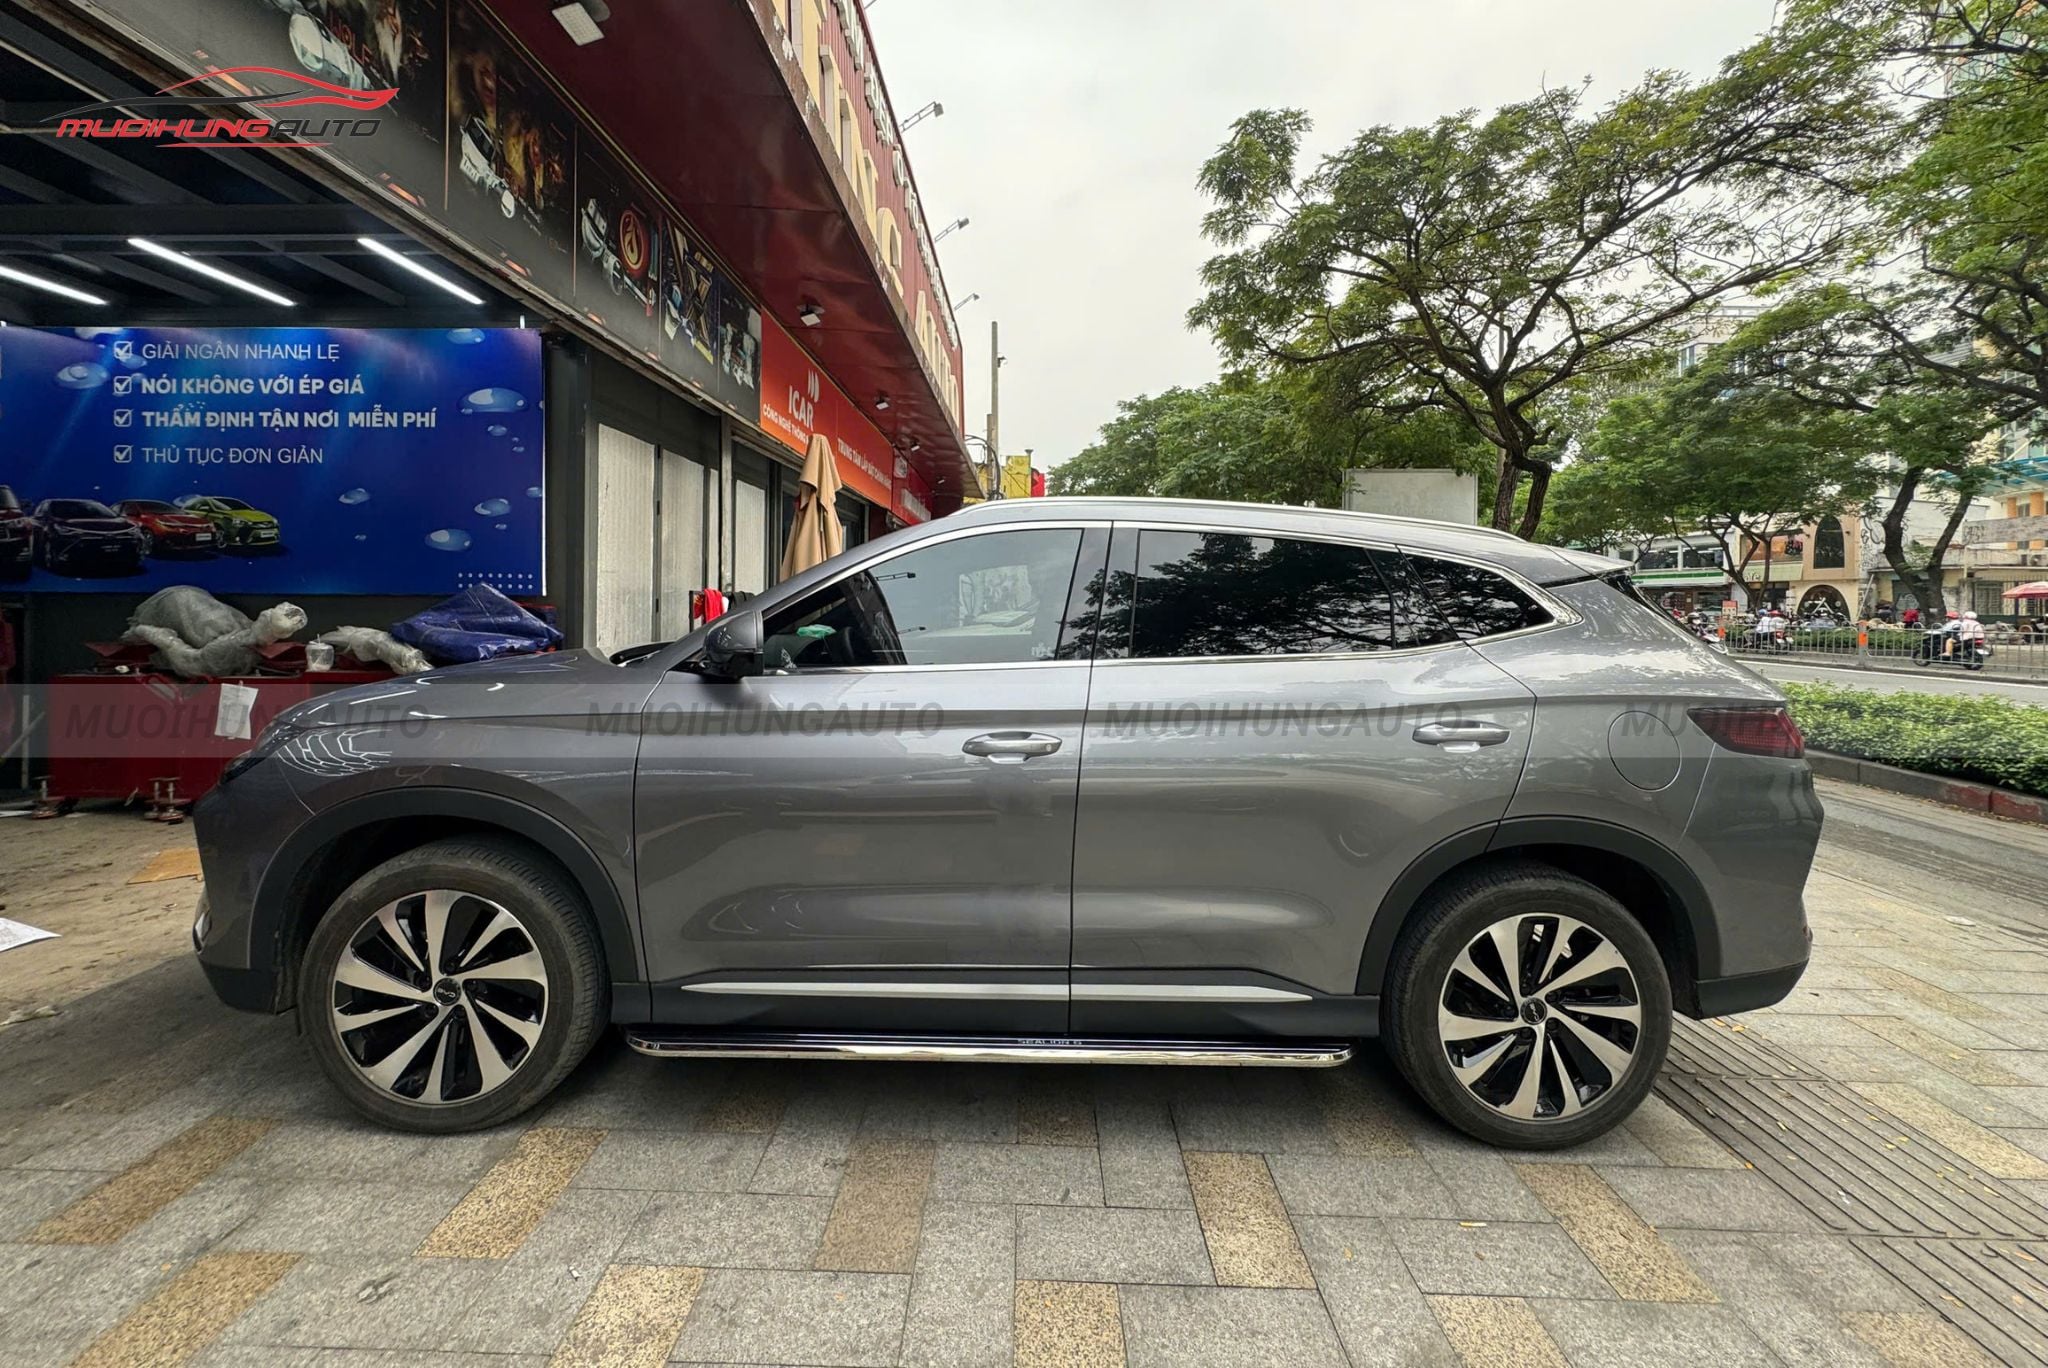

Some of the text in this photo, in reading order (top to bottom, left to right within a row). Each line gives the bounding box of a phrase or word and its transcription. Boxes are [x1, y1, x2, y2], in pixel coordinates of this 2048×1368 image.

[142, 340, 340, 362] GIẢI NGÂN NHANH LẸ
[141, 373, 365, 395] NÓI KHÔNG VỚI ÉP GIÁ
[142, 404, 437, 432] THẨM ĐỊNH TẬN NƠI MIỄN PHÍ
[788, 385, 814, 432] ICAR
[142, 444, 324, 466] THỦ TỤC ĐƠN GIẢN
